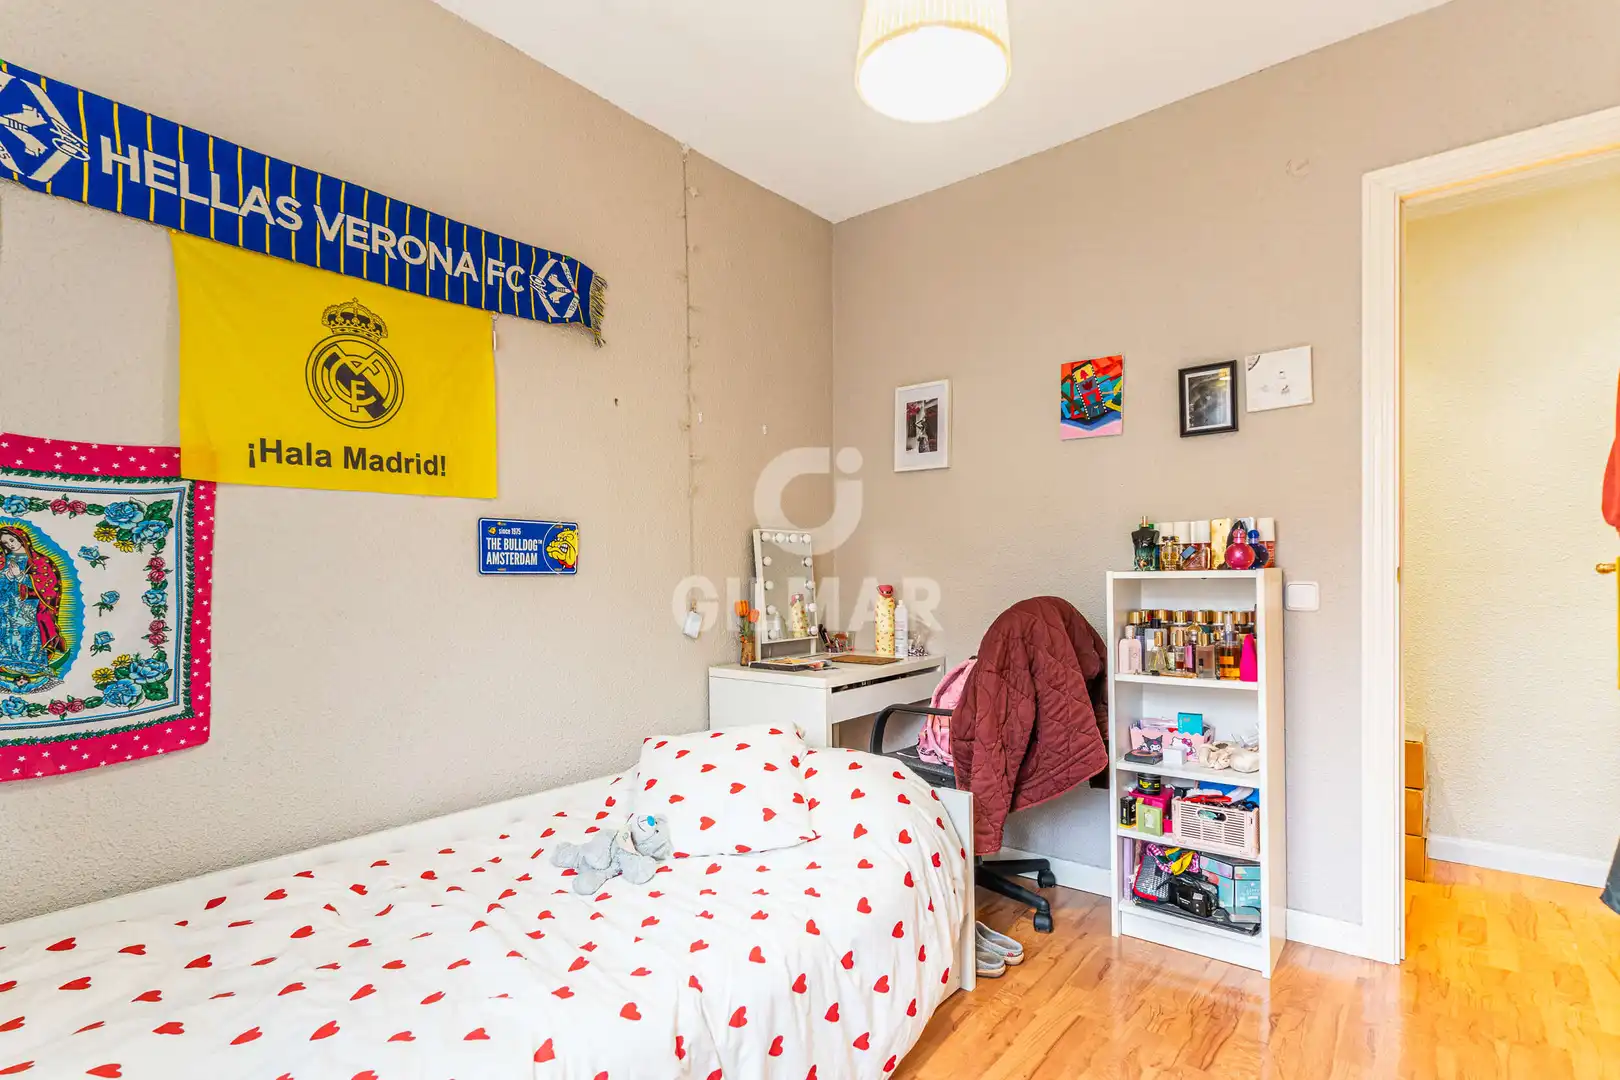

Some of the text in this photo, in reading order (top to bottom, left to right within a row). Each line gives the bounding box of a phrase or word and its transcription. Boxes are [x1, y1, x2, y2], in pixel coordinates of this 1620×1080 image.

[100, 134, 525, 293] HELLAS VERONA FC
[248, 437, 446, 477] ¡Hala Madrid!
[486, 537, 502, 550] THE
[486, 551, 538, 566] AMSTERDAM
